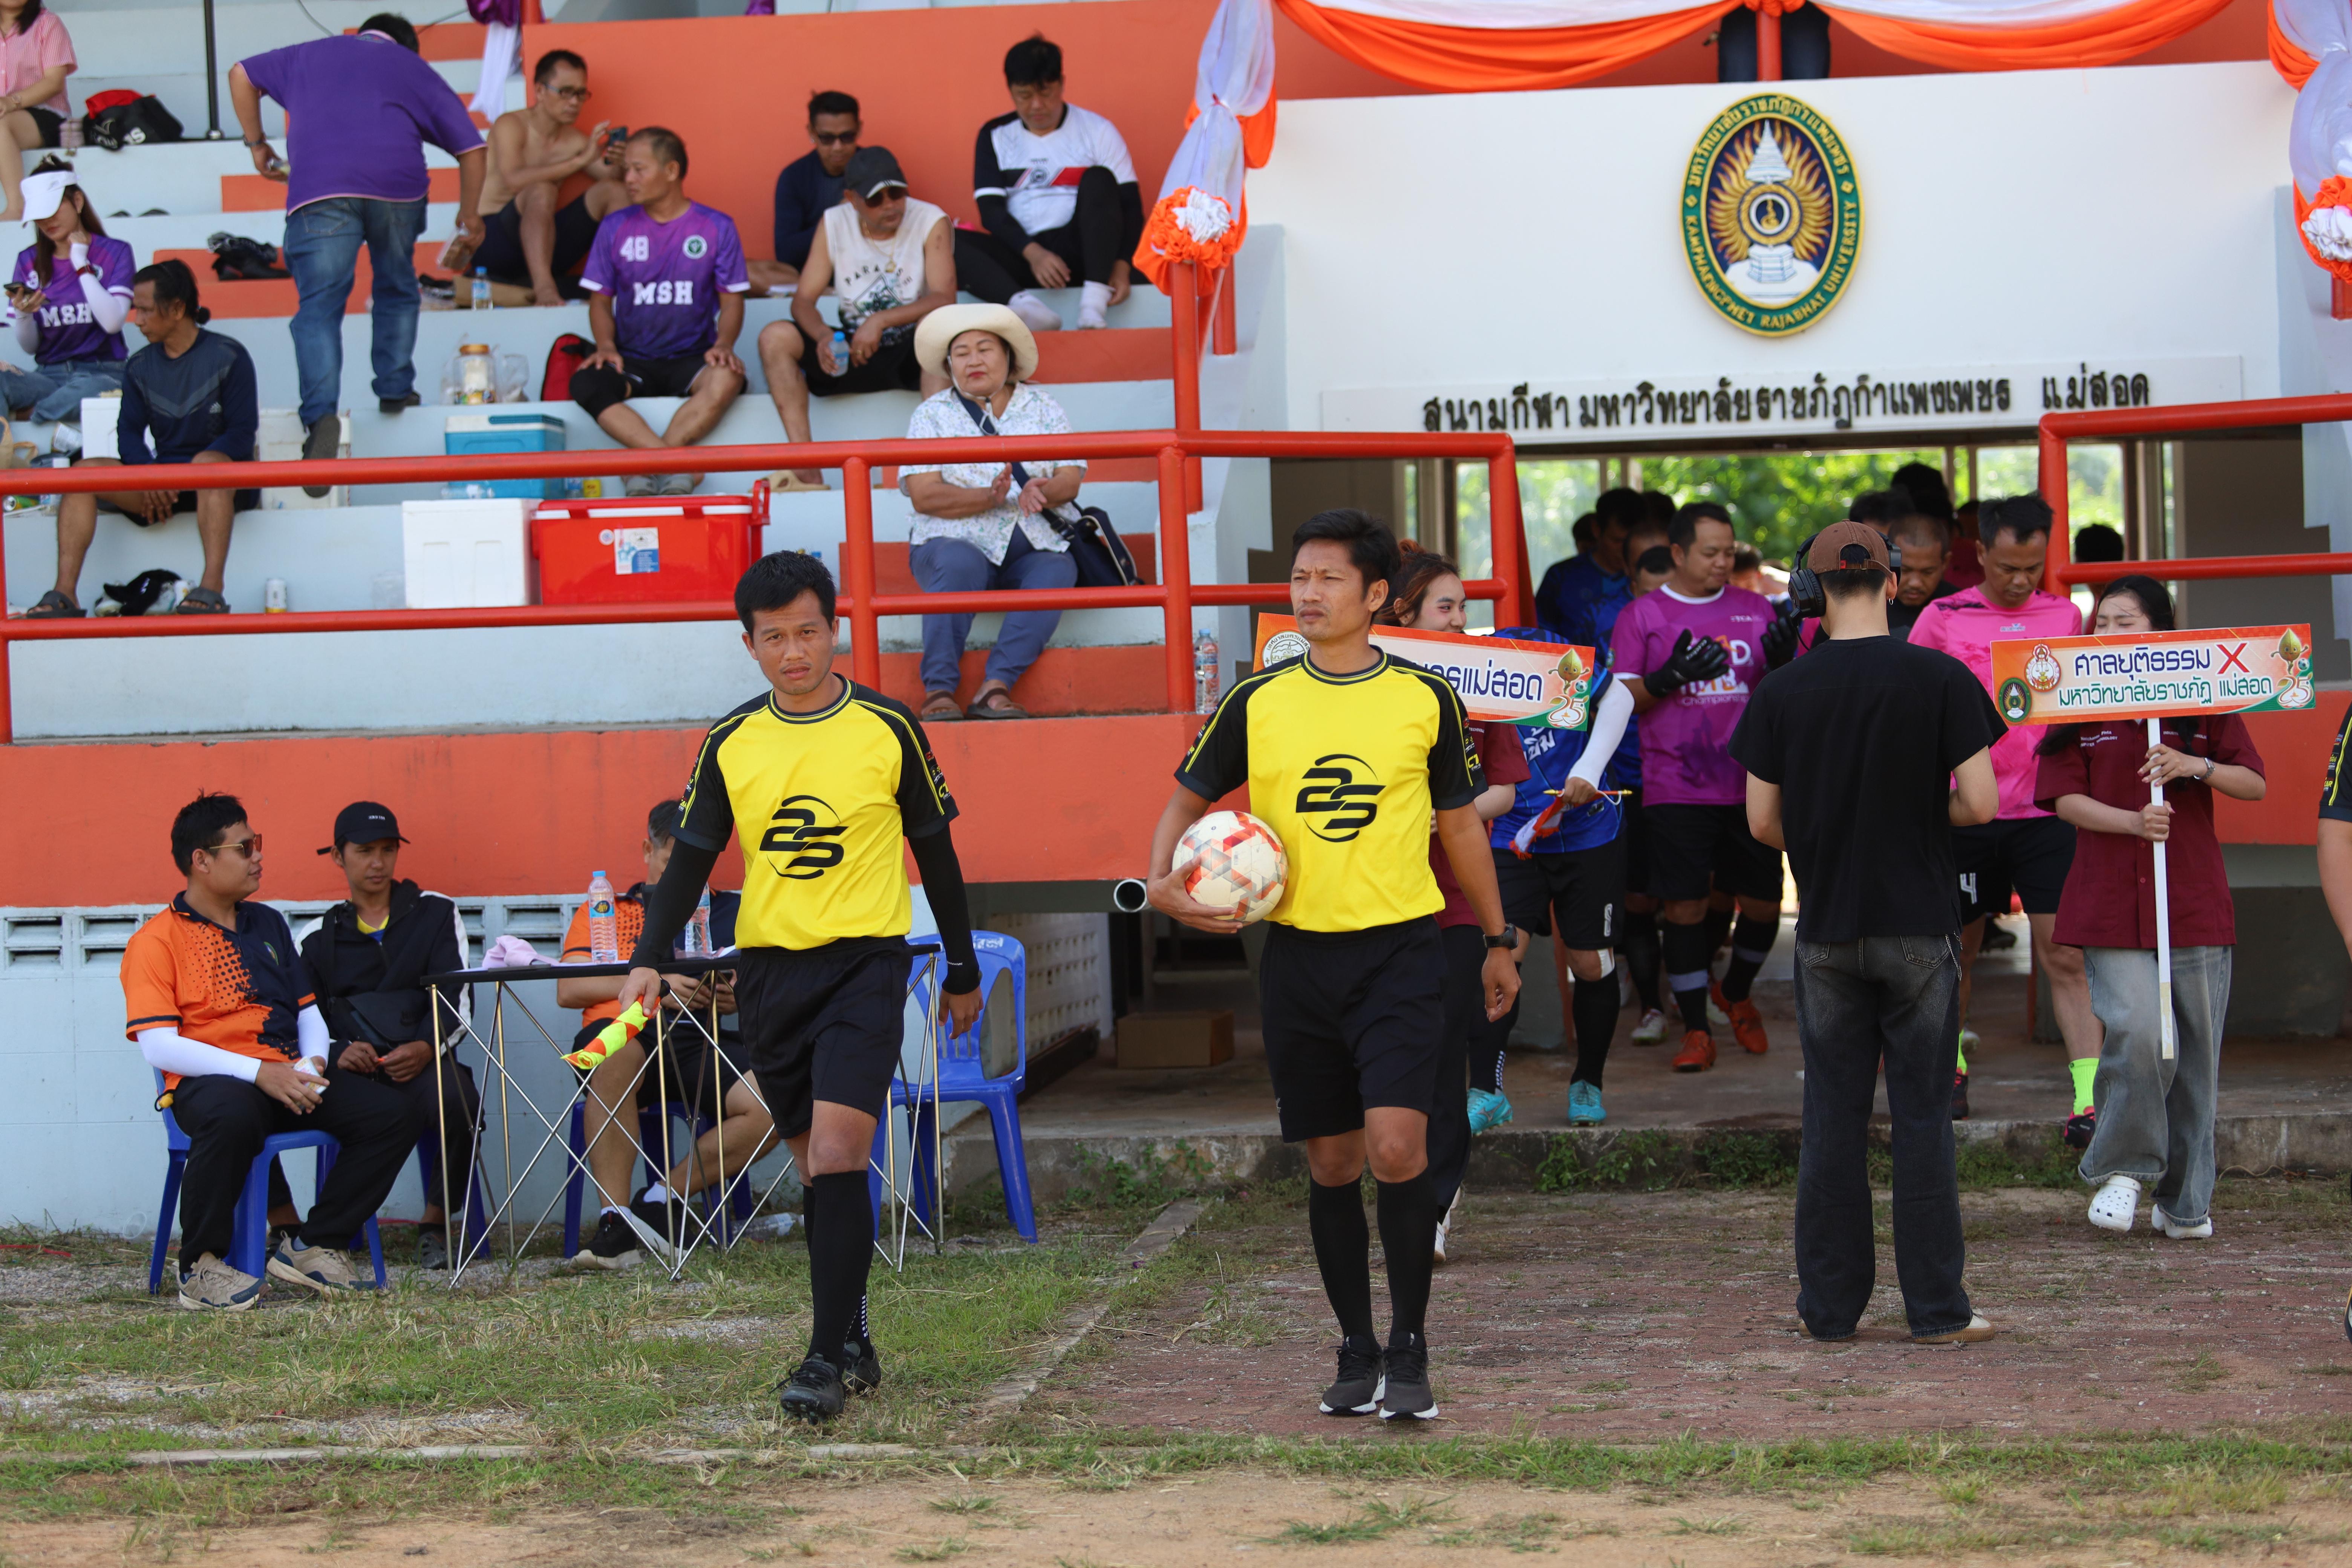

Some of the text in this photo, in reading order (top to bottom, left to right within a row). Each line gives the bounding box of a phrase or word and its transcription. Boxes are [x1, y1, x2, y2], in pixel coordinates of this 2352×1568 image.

[1760, 291, 1827, 329] RAJABHAT
[1822, 200, 1857, 293] UNIVERSITY
[633, 280, 694, 306] MSH
[40, 302, 93, 328] MSH
[2042, 362, 2149, 409] แม่สอด
[2075, 643, 2250, 680] ศาลยุติธรรม X
[2059, 672, 2273, 706] มหาวิทยาลัยราชภัฏ แม่สอด
[1960, 873, 1977, 904] 4
